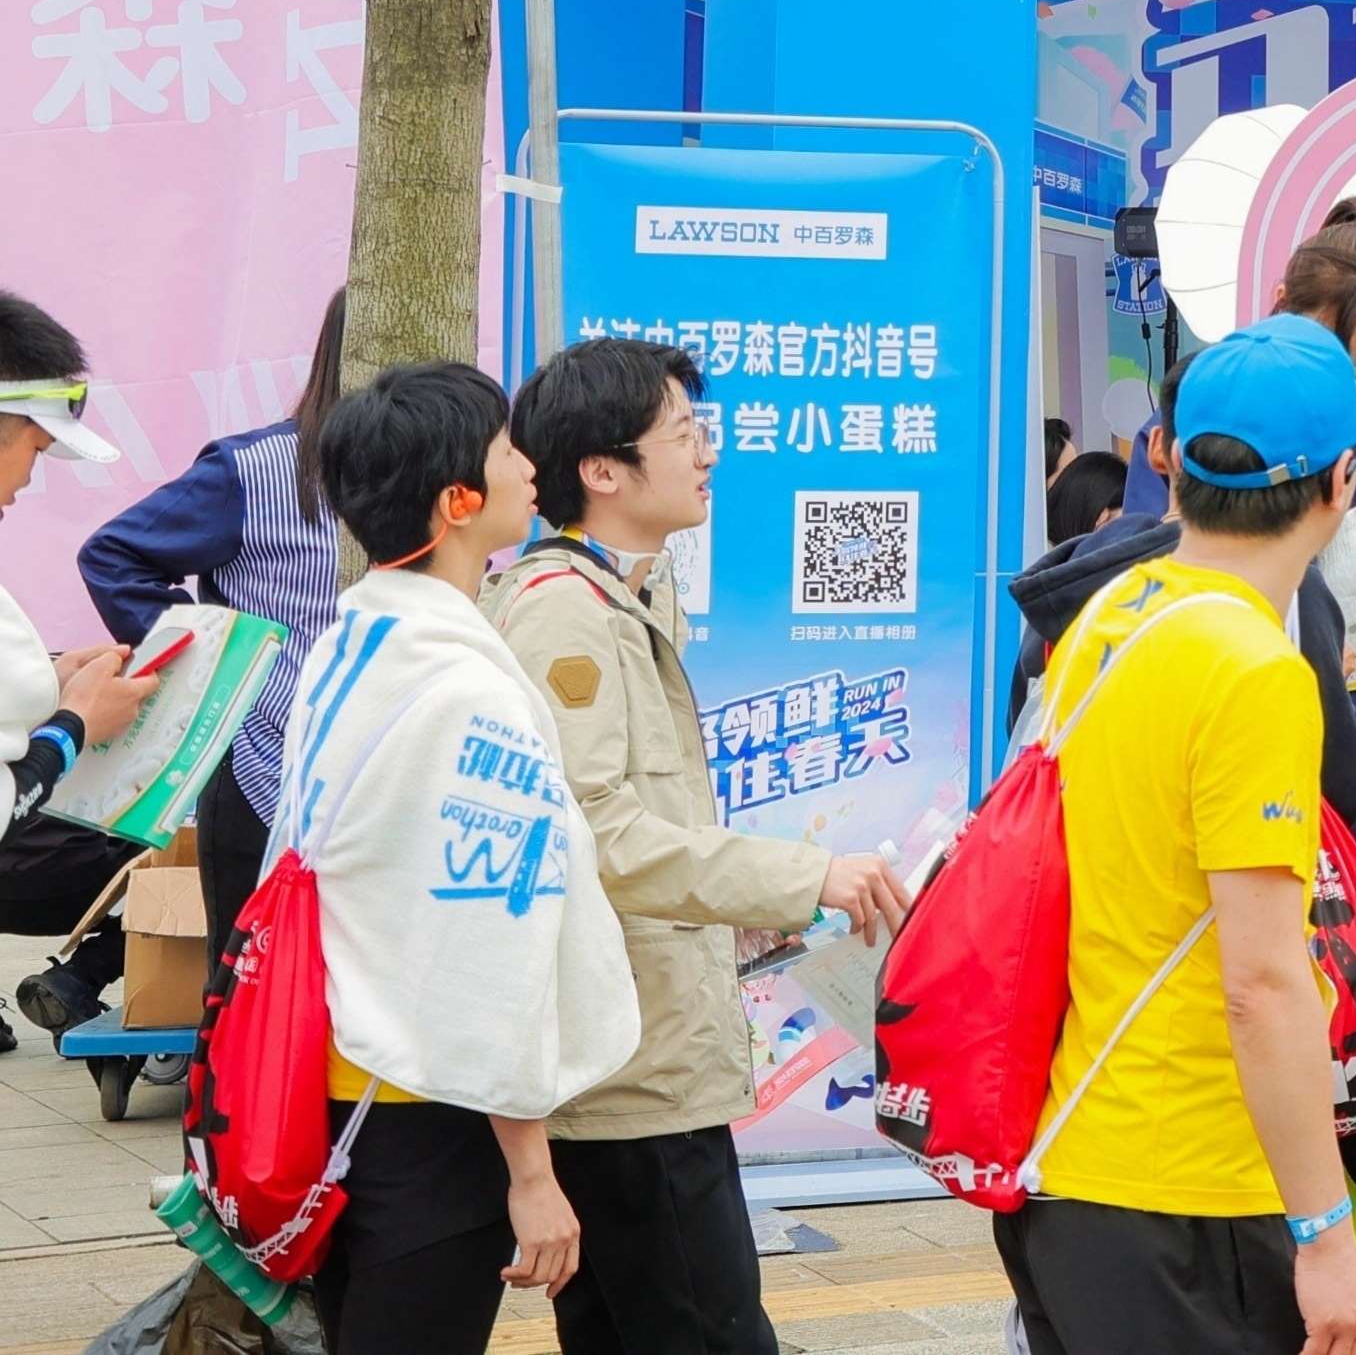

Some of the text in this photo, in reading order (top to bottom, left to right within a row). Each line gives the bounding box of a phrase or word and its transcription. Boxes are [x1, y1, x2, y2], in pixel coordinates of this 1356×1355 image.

[649, 220, 780, 245] LAWSON
[794, 225, 875, 247] 中百罗森
[791, 625, 916, 641] 扫码进入直播相册
[844, 675, 901, 704] RUN IN
[842, 699, 882, 720] 2024
